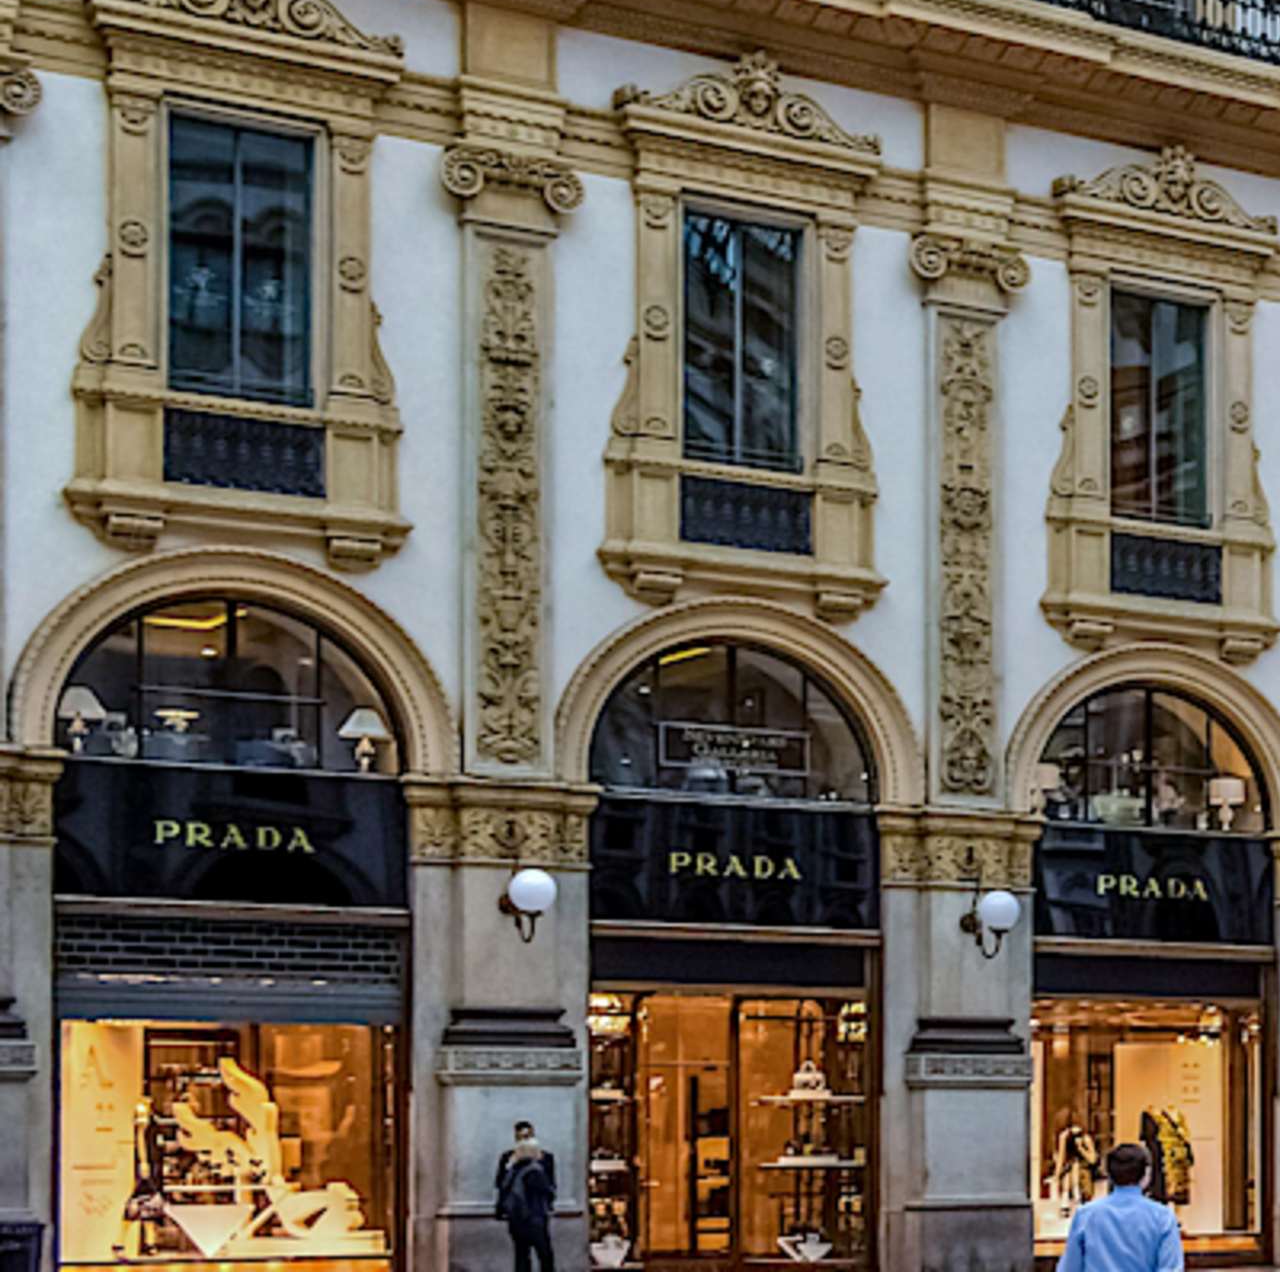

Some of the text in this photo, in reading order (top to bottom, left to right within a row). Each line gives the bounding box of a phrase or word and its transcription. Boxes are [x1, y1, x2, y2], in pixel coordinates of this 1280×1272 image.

[153, 819, 316, 854] PRADA
[668, 851, 803, 880] PRADA
[1096, 874, 1209, 902] PRADA
